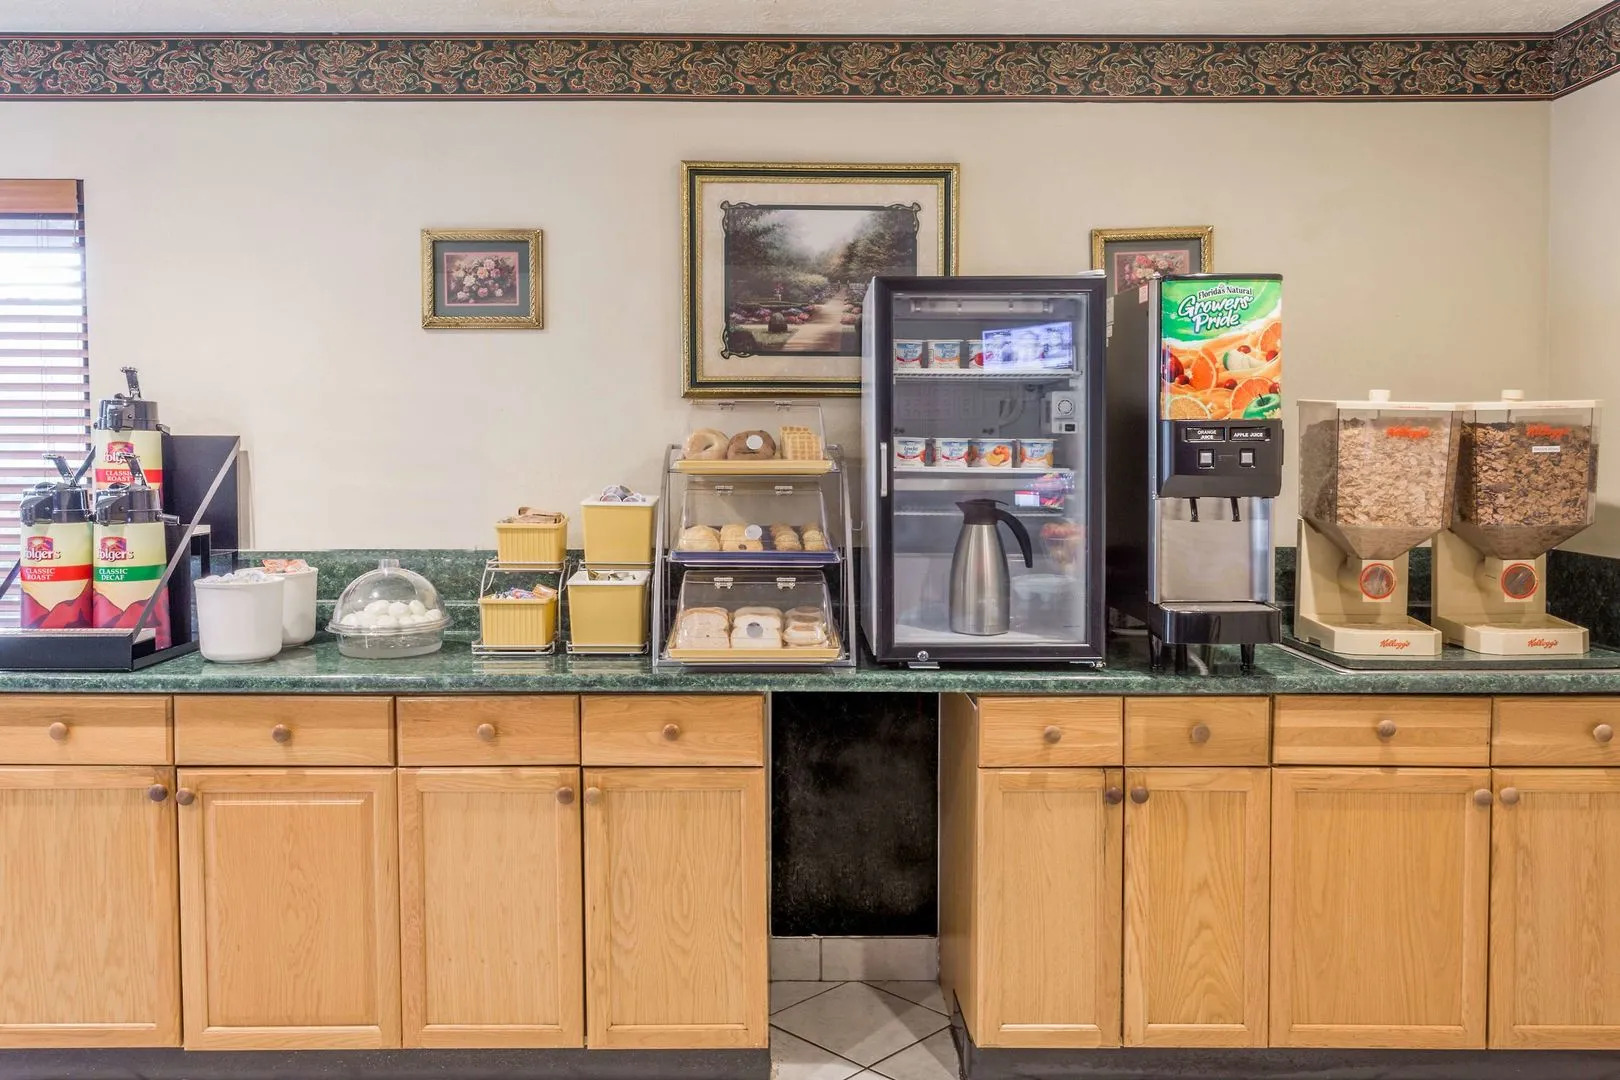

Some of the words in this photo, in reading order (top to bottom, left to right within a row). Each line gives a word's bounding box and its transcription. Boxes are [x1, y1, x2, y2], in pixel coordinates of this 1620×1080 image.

[1227, 286, 1253, 295] Natural
[1191, 309, 1241, 334] Pride
[25, 567, 56, 575] CLASSIC
[98, 567, 129, 575] CLASSIC
